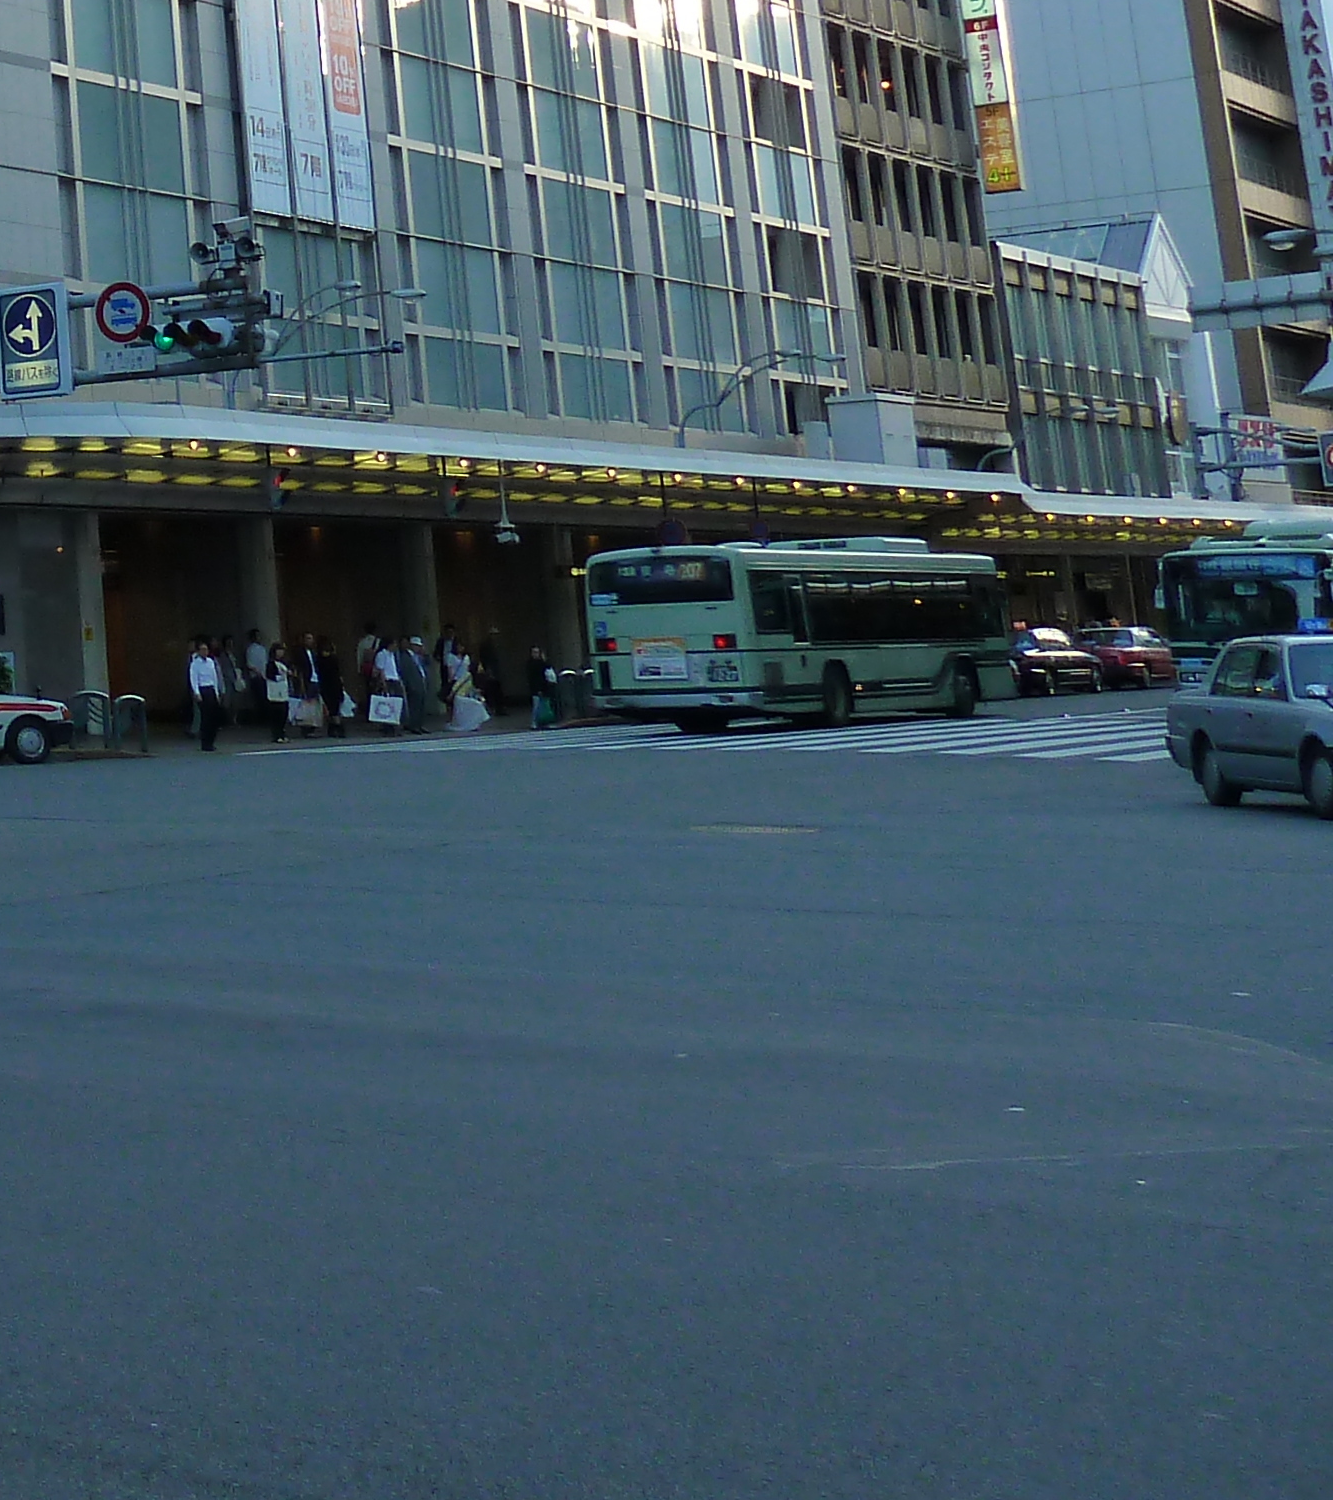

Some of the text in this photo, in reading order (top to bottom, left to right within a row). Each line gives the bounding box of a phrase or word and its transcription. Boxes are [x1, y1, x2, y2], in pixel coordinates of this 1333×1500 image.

[334, 77, 356, 95] OFF
[6, 365, 58, 384] 路線バスを除く
